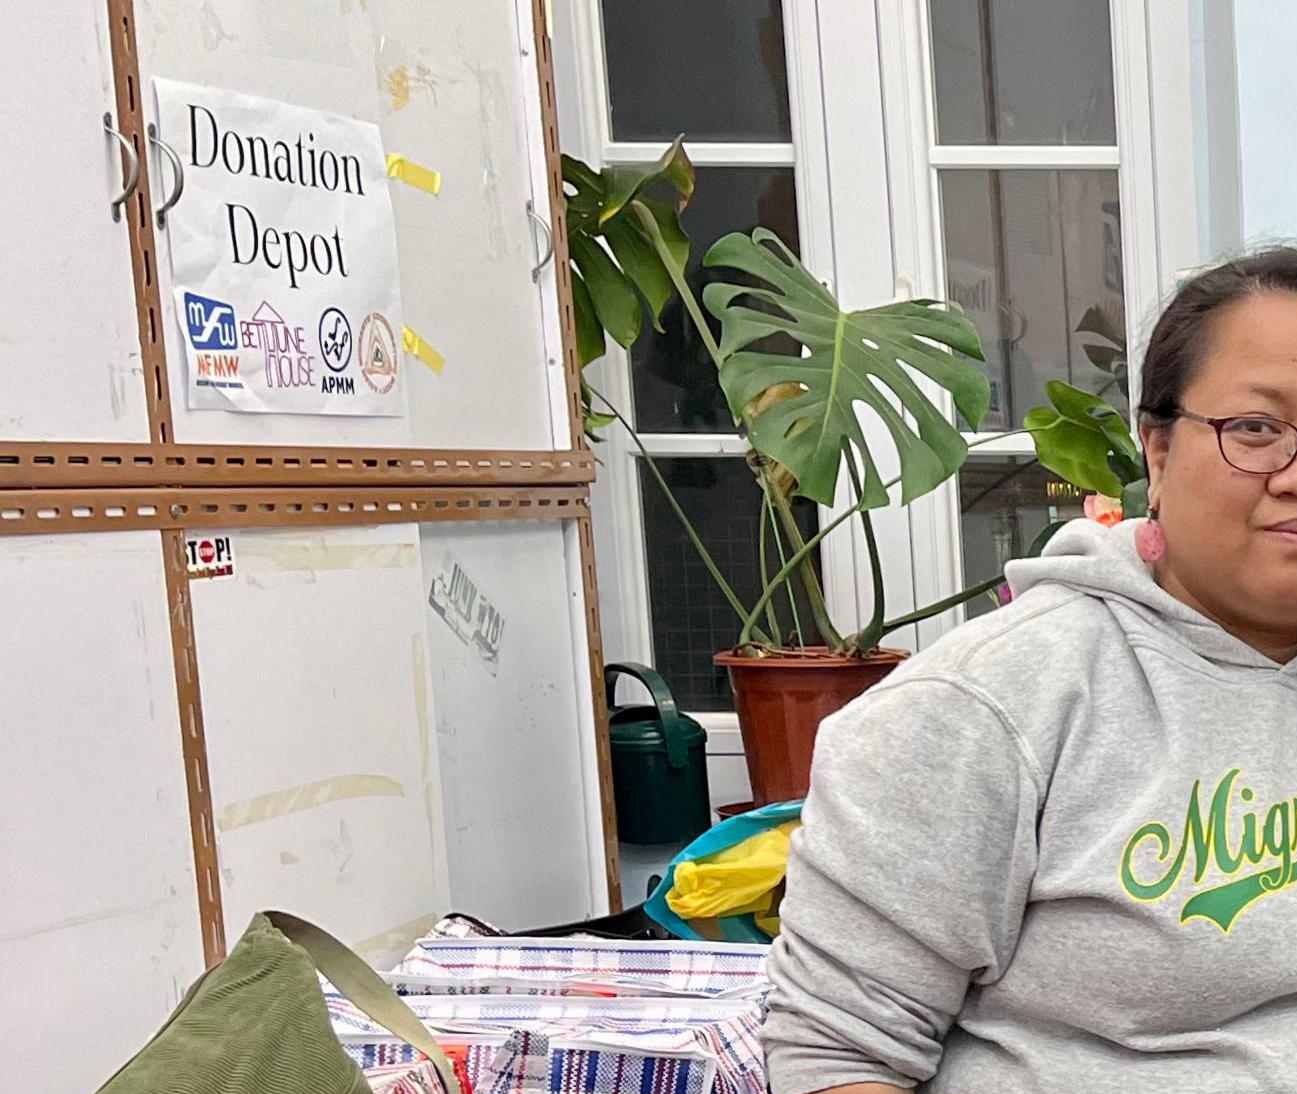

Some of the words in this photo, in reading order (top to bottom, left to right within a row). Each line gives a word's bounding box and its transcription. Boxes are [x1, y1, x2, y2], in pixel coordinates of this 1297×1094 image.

[187, 104, 366, 197] Donation
[225, 203, 349, 290] Depot
[321, 375, 355, 395] APMM
